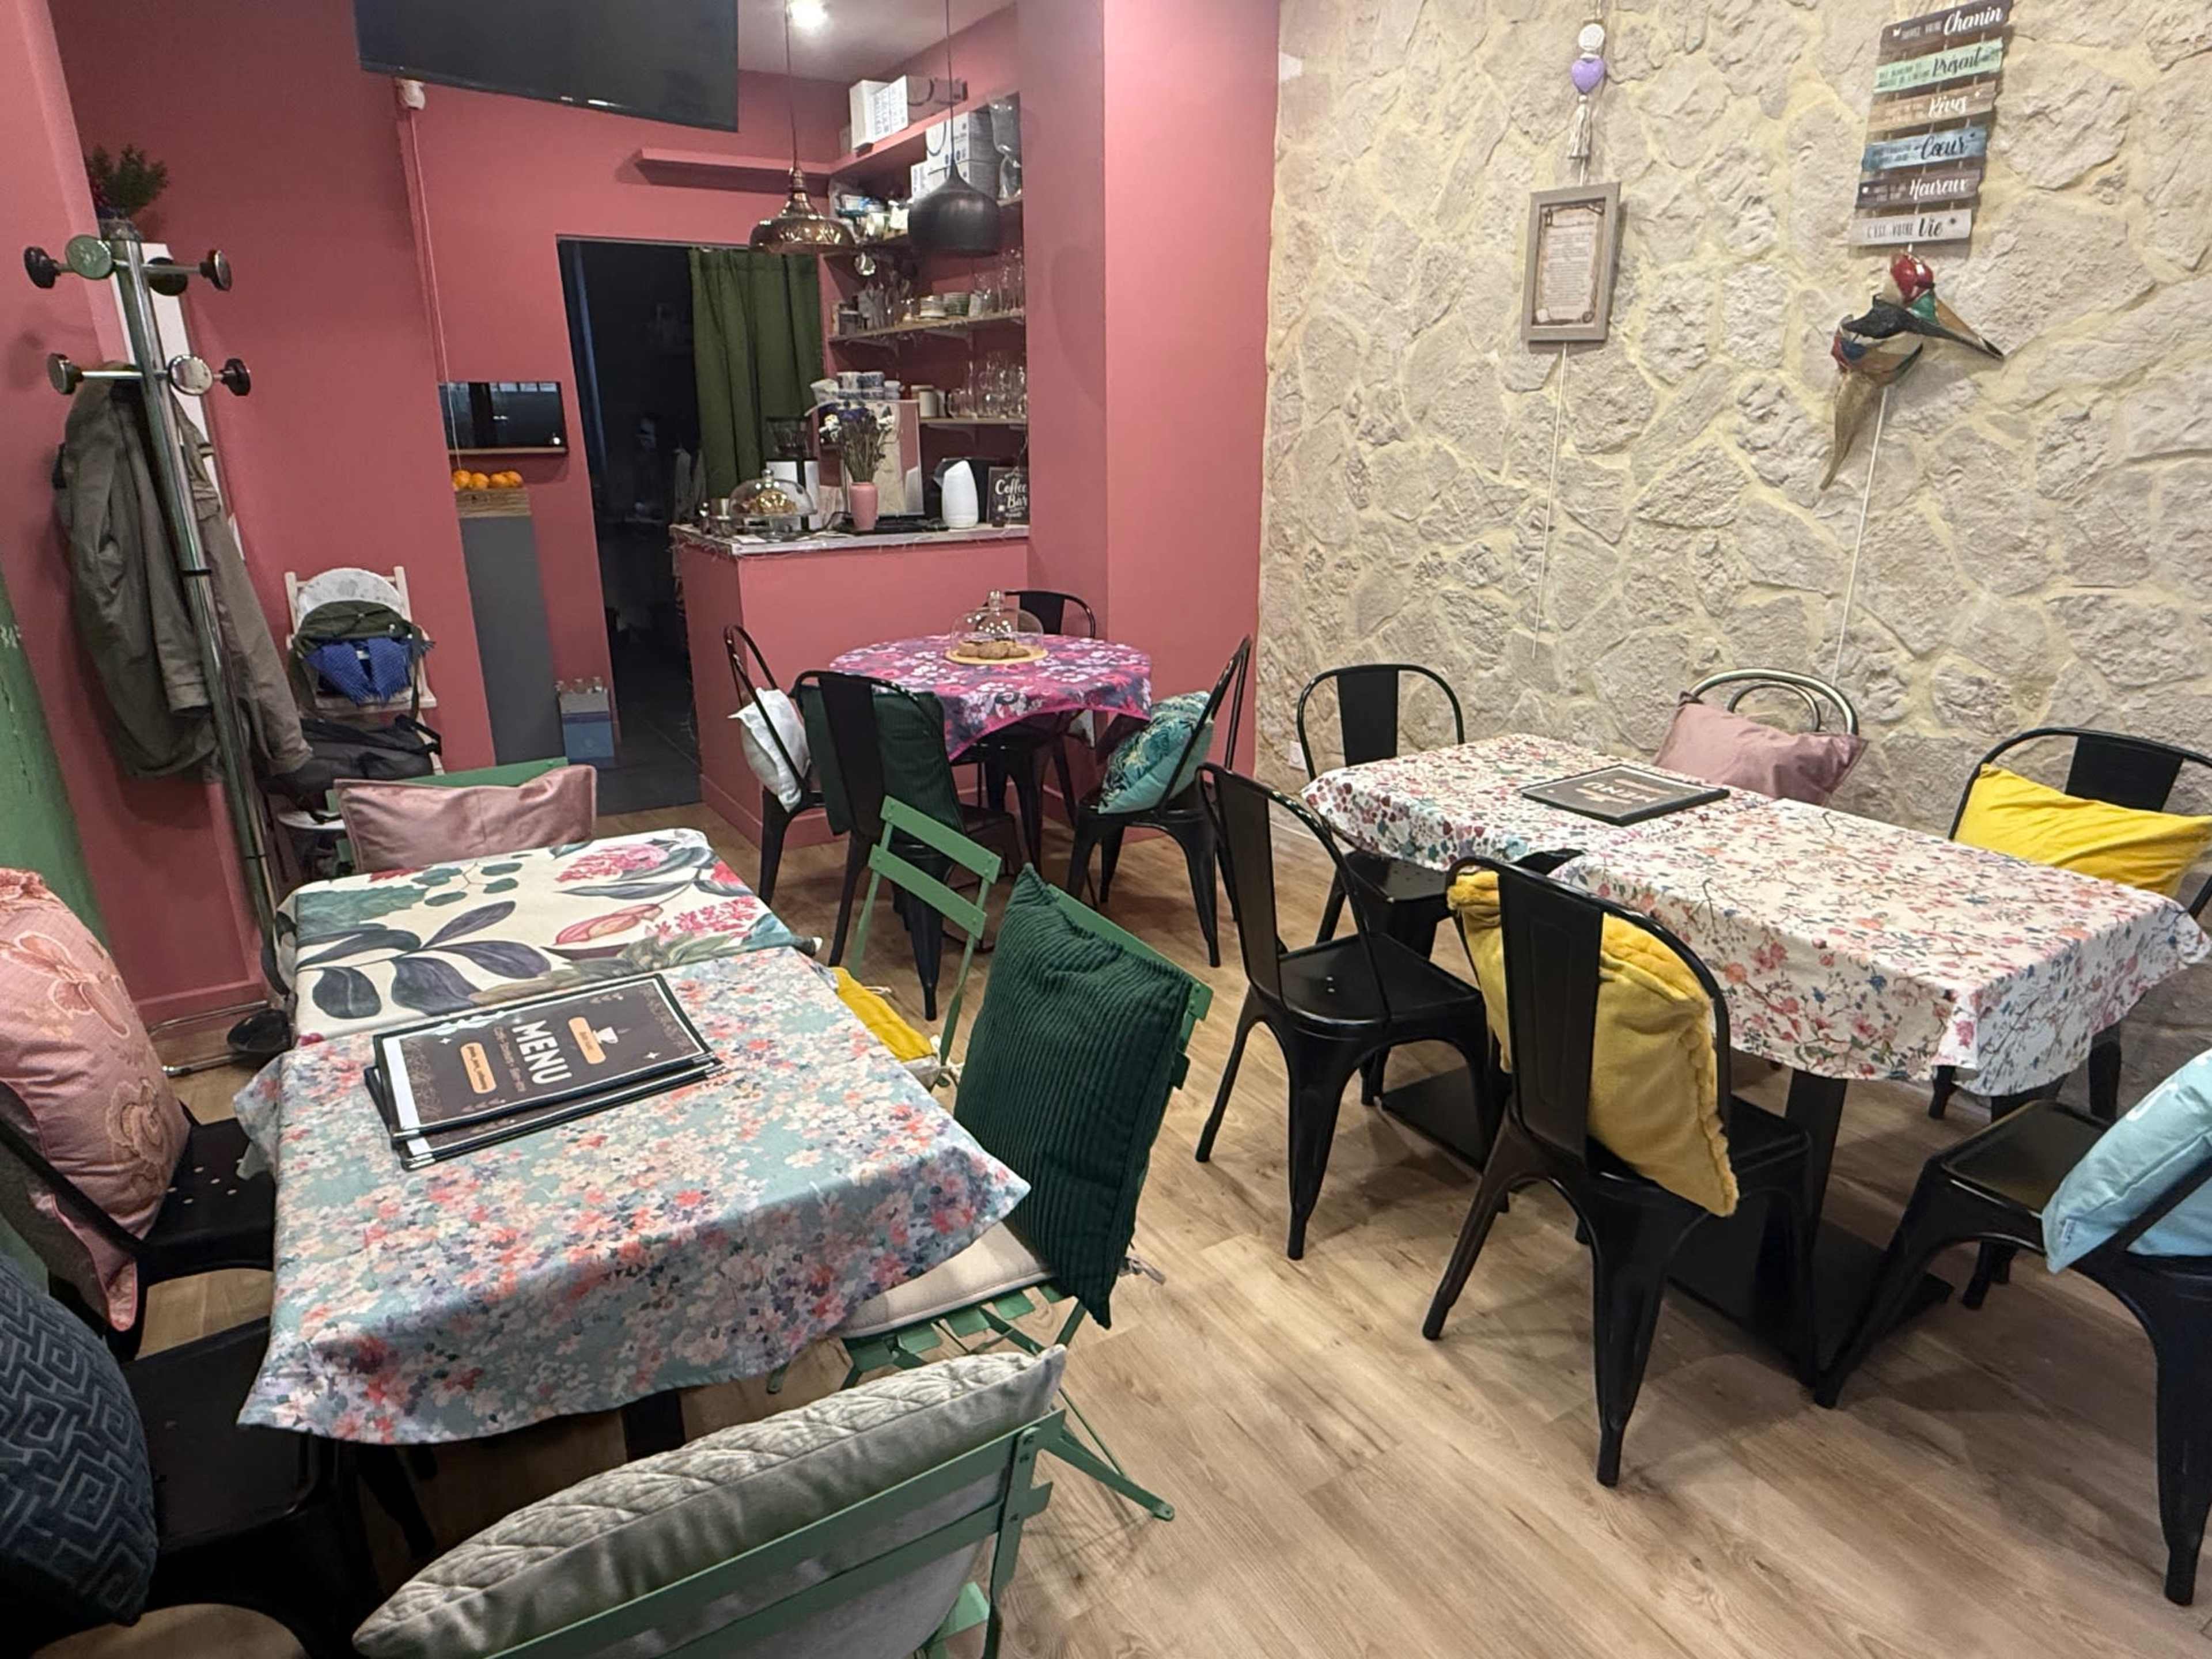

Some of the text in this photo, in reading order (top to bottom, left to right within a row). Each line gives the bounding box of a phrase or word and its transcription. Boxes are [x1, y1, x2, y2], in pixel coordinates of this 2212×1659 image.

[1909, 177, 1969, 200] Heureux
[1918, 217, 1943, 237] Vie
[995, 478, 1027, 495] Coffee
[1007, 494, 1028, 508] Bar
[512, 1020, 572, 1084] MENU
